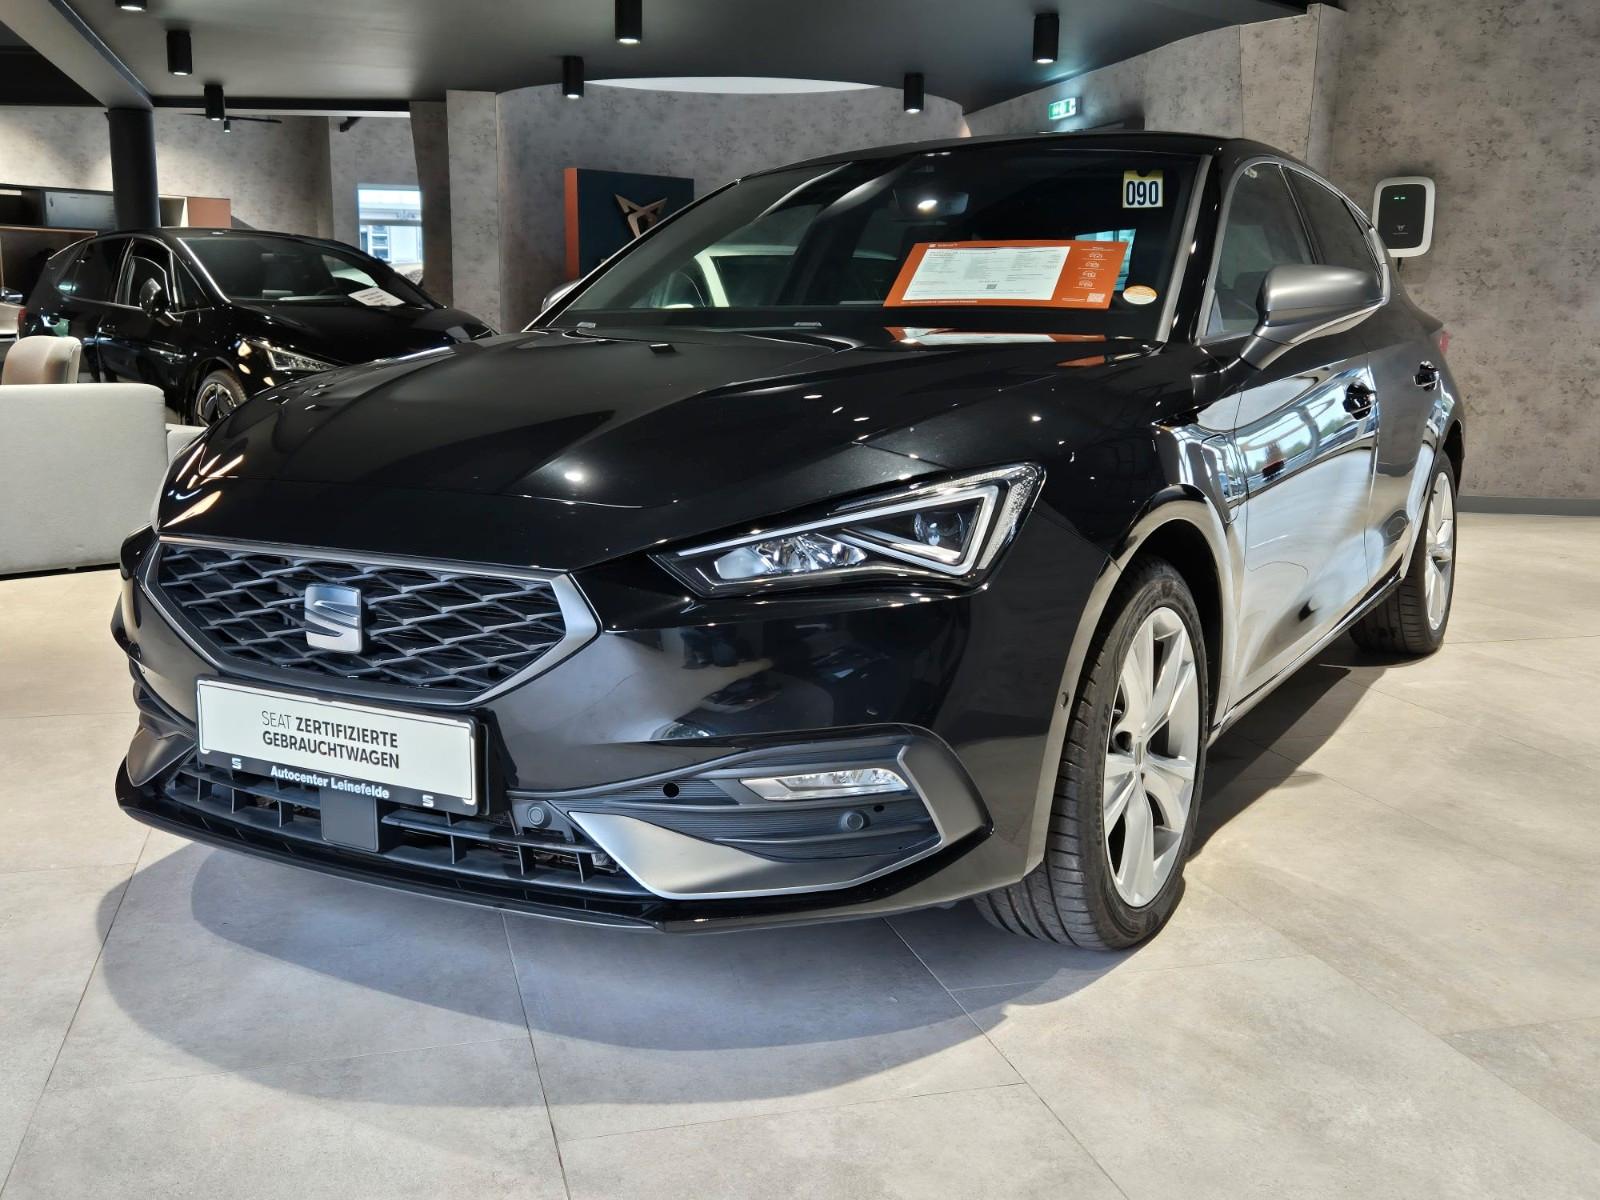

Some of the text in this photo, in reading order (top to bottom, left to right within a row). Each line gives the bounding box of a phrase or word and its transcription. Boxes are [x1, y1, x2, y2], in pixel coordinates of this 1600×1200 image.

[1126, 181, 1159, 206] 090
[262, 710, 399, 748] SEAT ZERTIFIZIERTE
[262, 731, 400, 769] GEBRAUCHTWAGEN
[270, 765, 329, 787] Autocenter
[330, 777, 390, 799] Leinefelde
